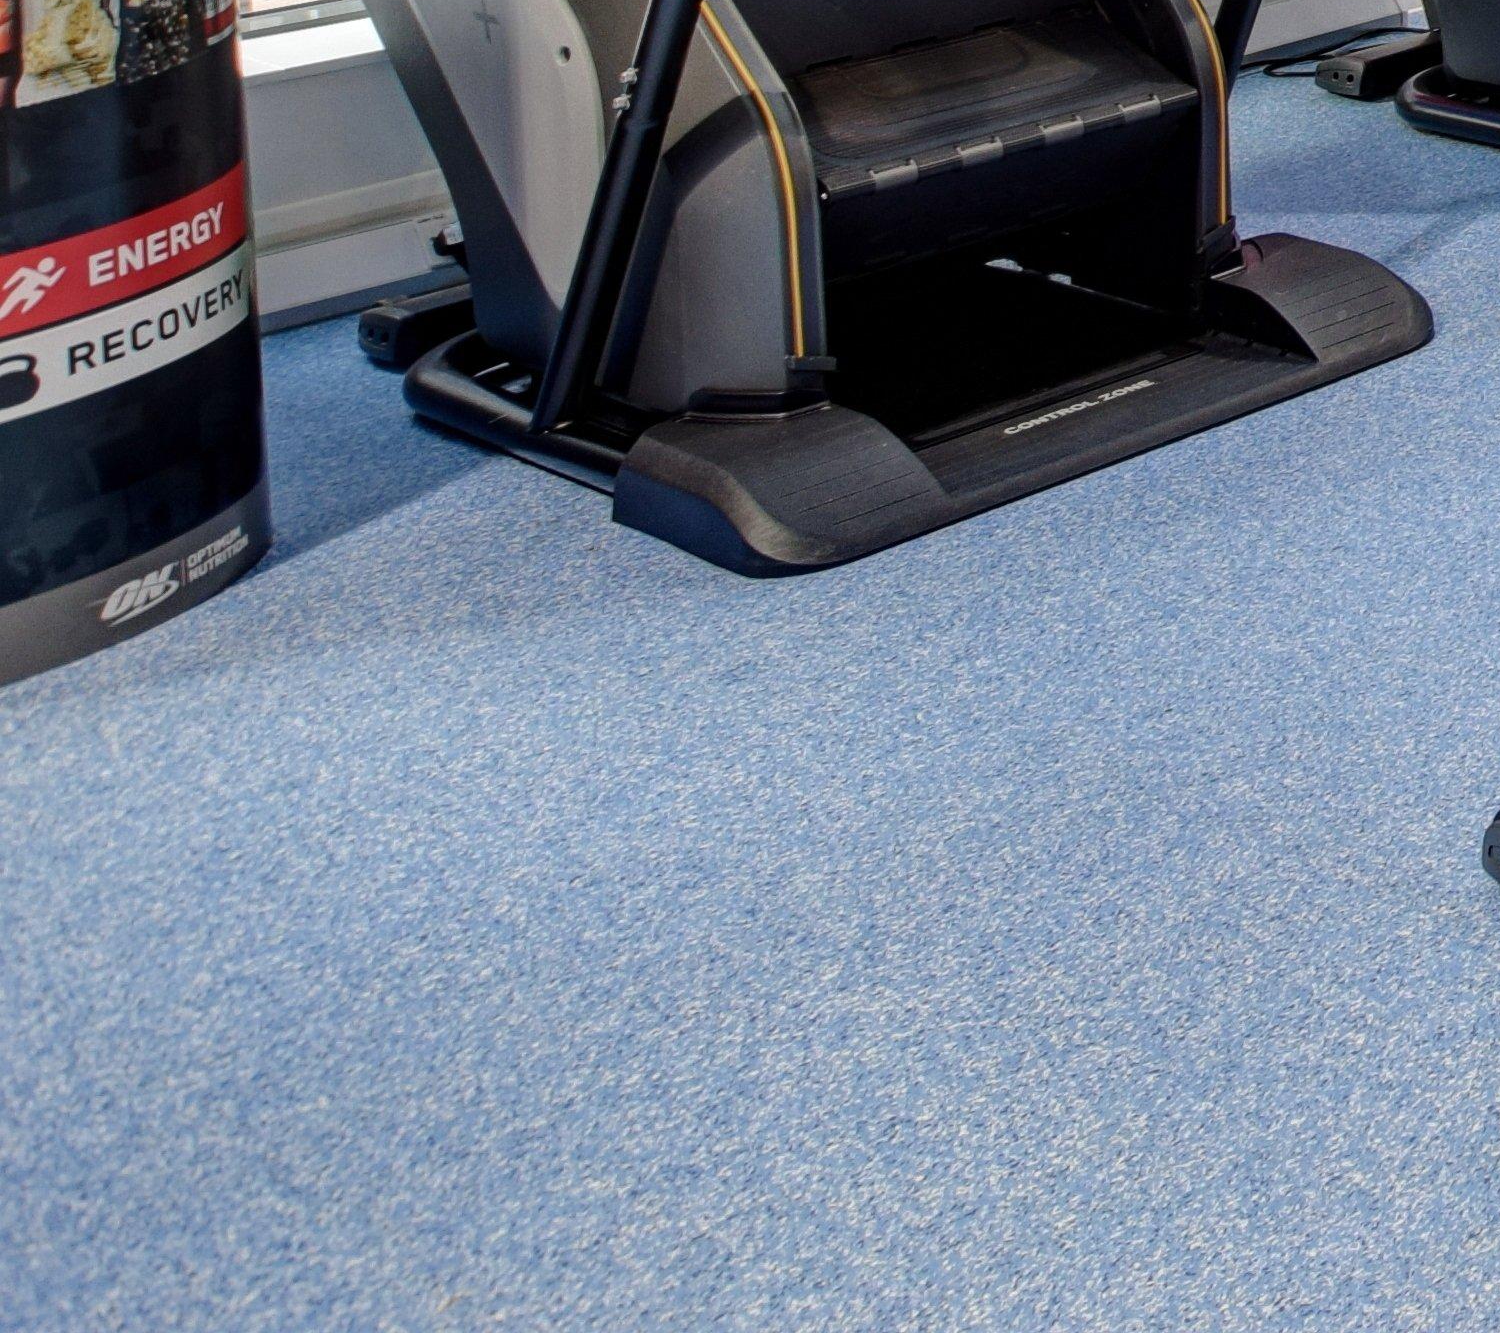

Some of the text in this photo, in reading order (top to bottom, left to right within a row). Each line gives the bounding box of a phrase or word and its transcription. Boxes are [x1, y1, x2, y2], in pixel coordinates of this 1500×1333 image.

[88, 201, 225, 287] ENERGY
[68, 269, 246, 376] RECOVERY
[187, 525, 242, 566] OPTIMUM
